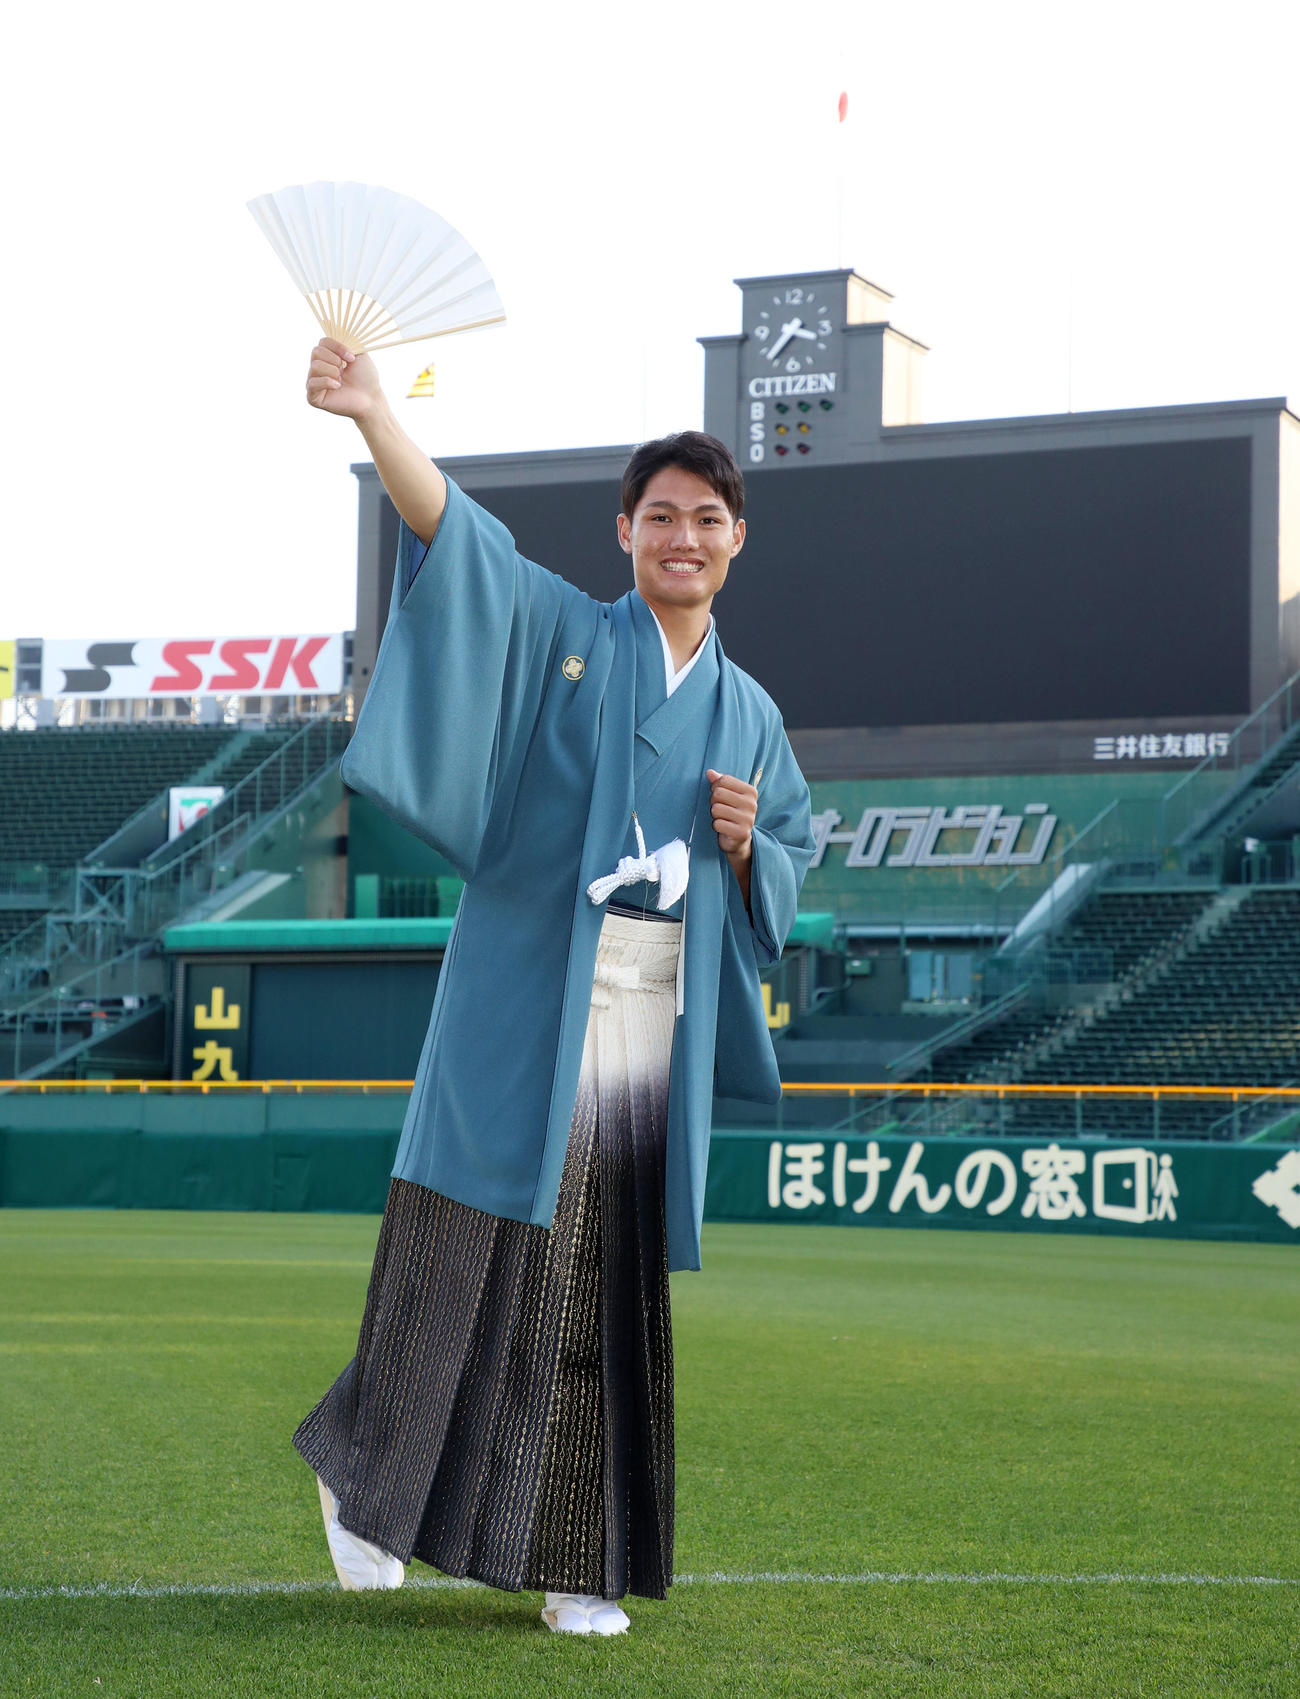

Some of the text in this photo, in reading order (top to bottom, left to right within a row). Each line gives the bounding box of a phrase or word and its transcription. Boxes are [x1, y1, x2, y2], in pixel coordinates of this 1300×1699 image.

[749, 373, 836, 398] CITIZEN
[150, 637, 331, 692] SSK
[1093, 732, 1230, 760] 三井住友銀行
[192, 986, 240, 1082] 山九
